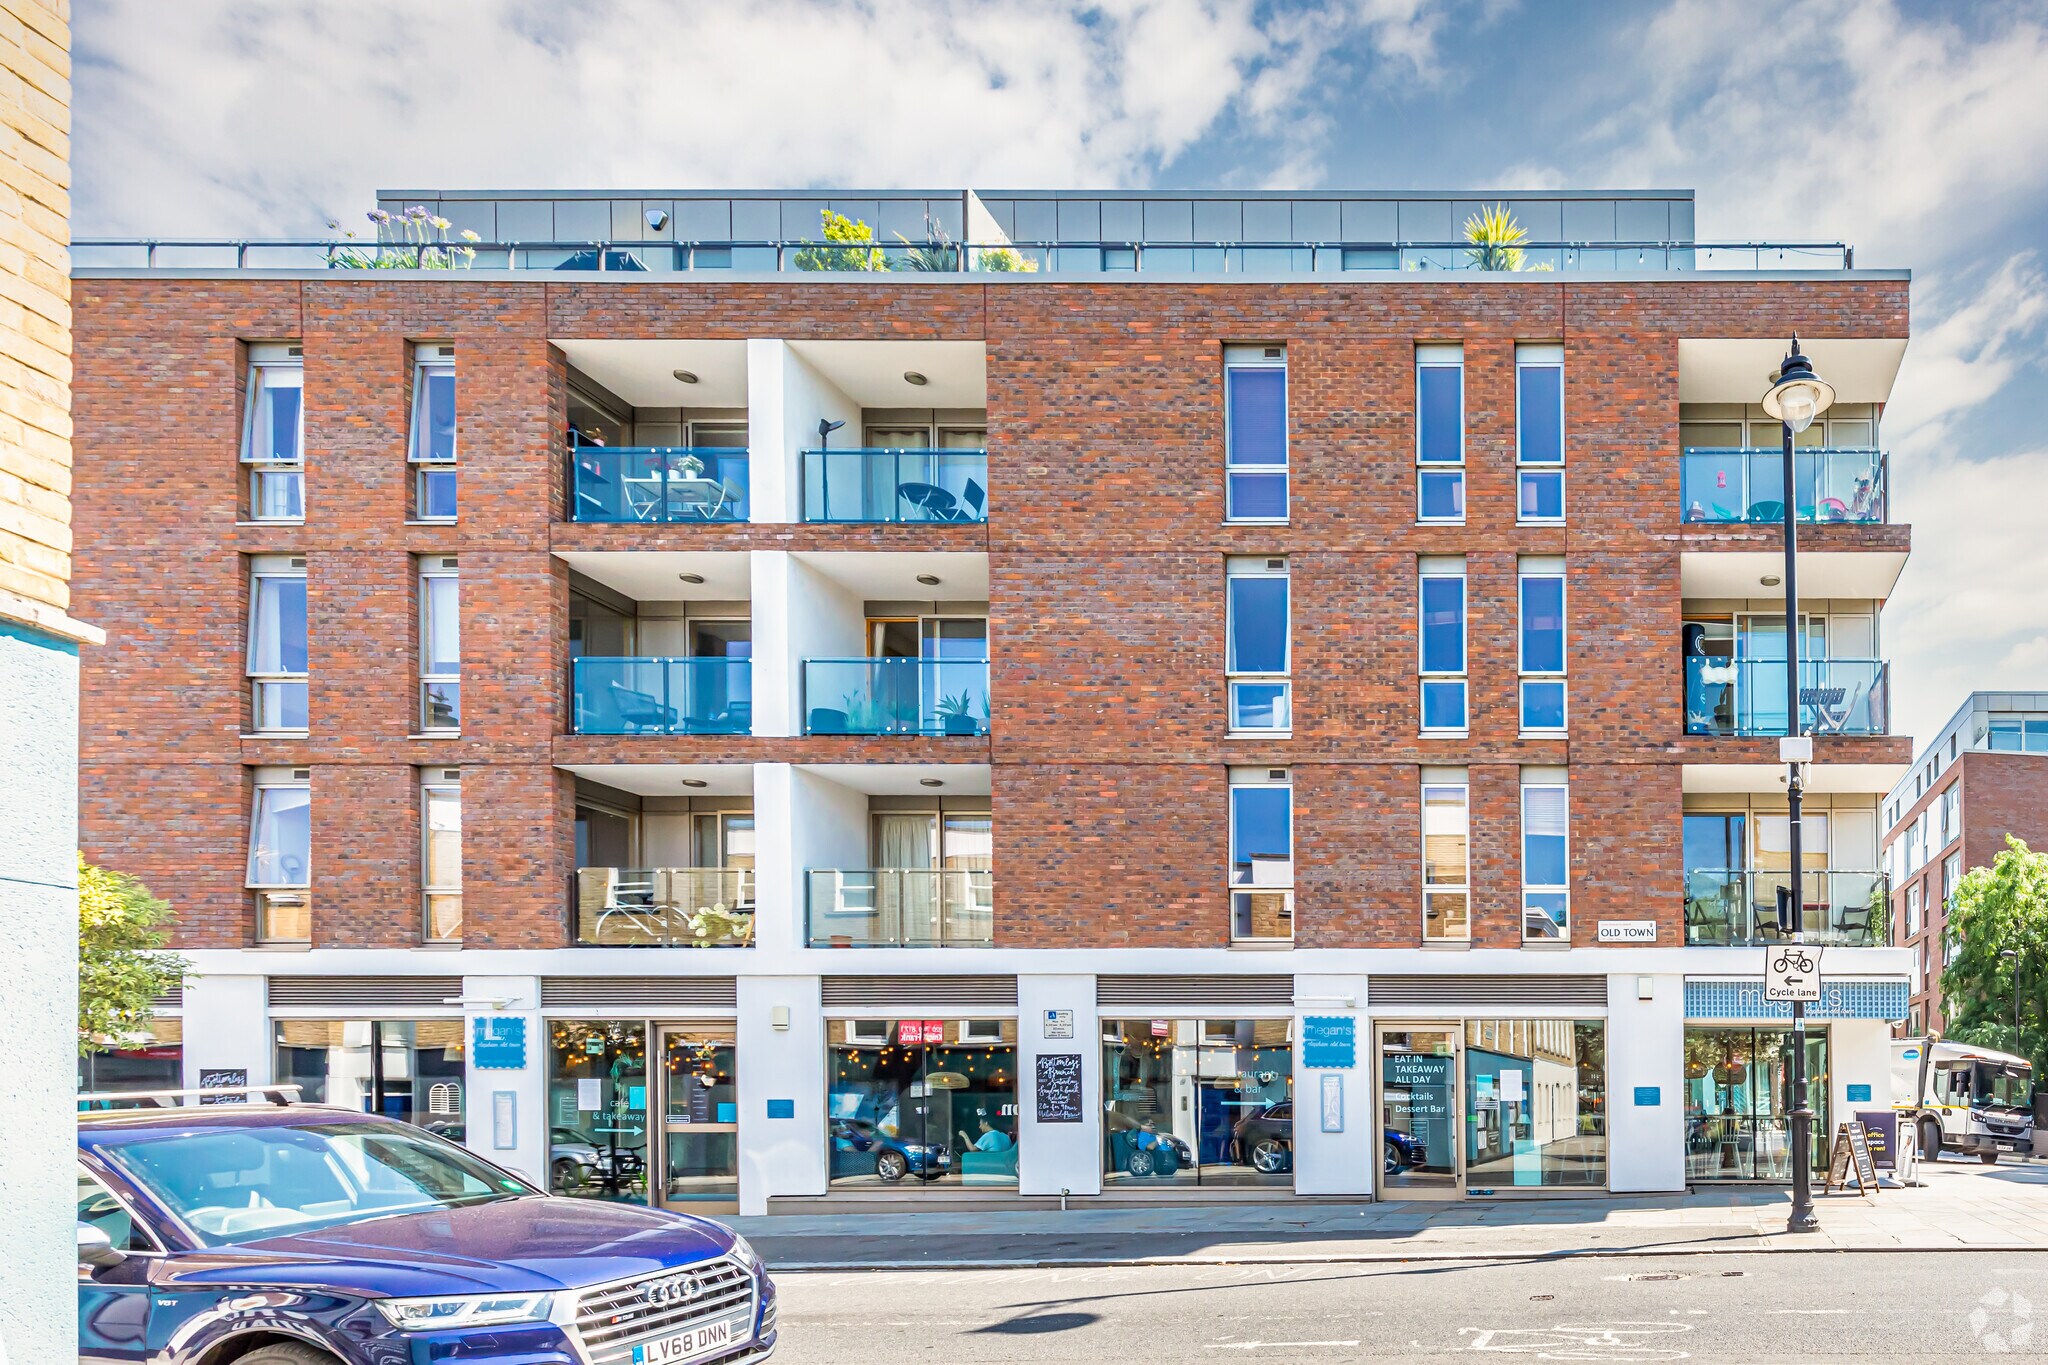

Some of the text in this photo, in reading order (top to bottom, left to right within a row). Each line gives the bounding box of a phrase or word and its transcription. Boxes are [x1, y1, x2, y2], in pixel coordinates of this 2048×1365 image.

[1601, 928, 1653, 937] OLD TOWN
[1769, 987, 1817, 997] Cycle lane
[476, 1026, 522, 1037] mgan's
[1306, 1025, 1352, 1038] megan's
[1394, 1055, 1423, 1063] EAT IN
[1395, 1065, 1445, 1073] TAKEAWAY
[1395, 1075, 1431, 1083] ALL DAY
[1234, 1083, 1263, 1094] & bar
[1395, 1092, 1434, 1101] Cocktails
[610, 1099, 630, 1107] café
[1395, 1105, 1446, 1113] Dessert Bar
[592, 1111, 646, 1122] & takeaway
[647, 1323, 727, 1363] LV68 DNN
